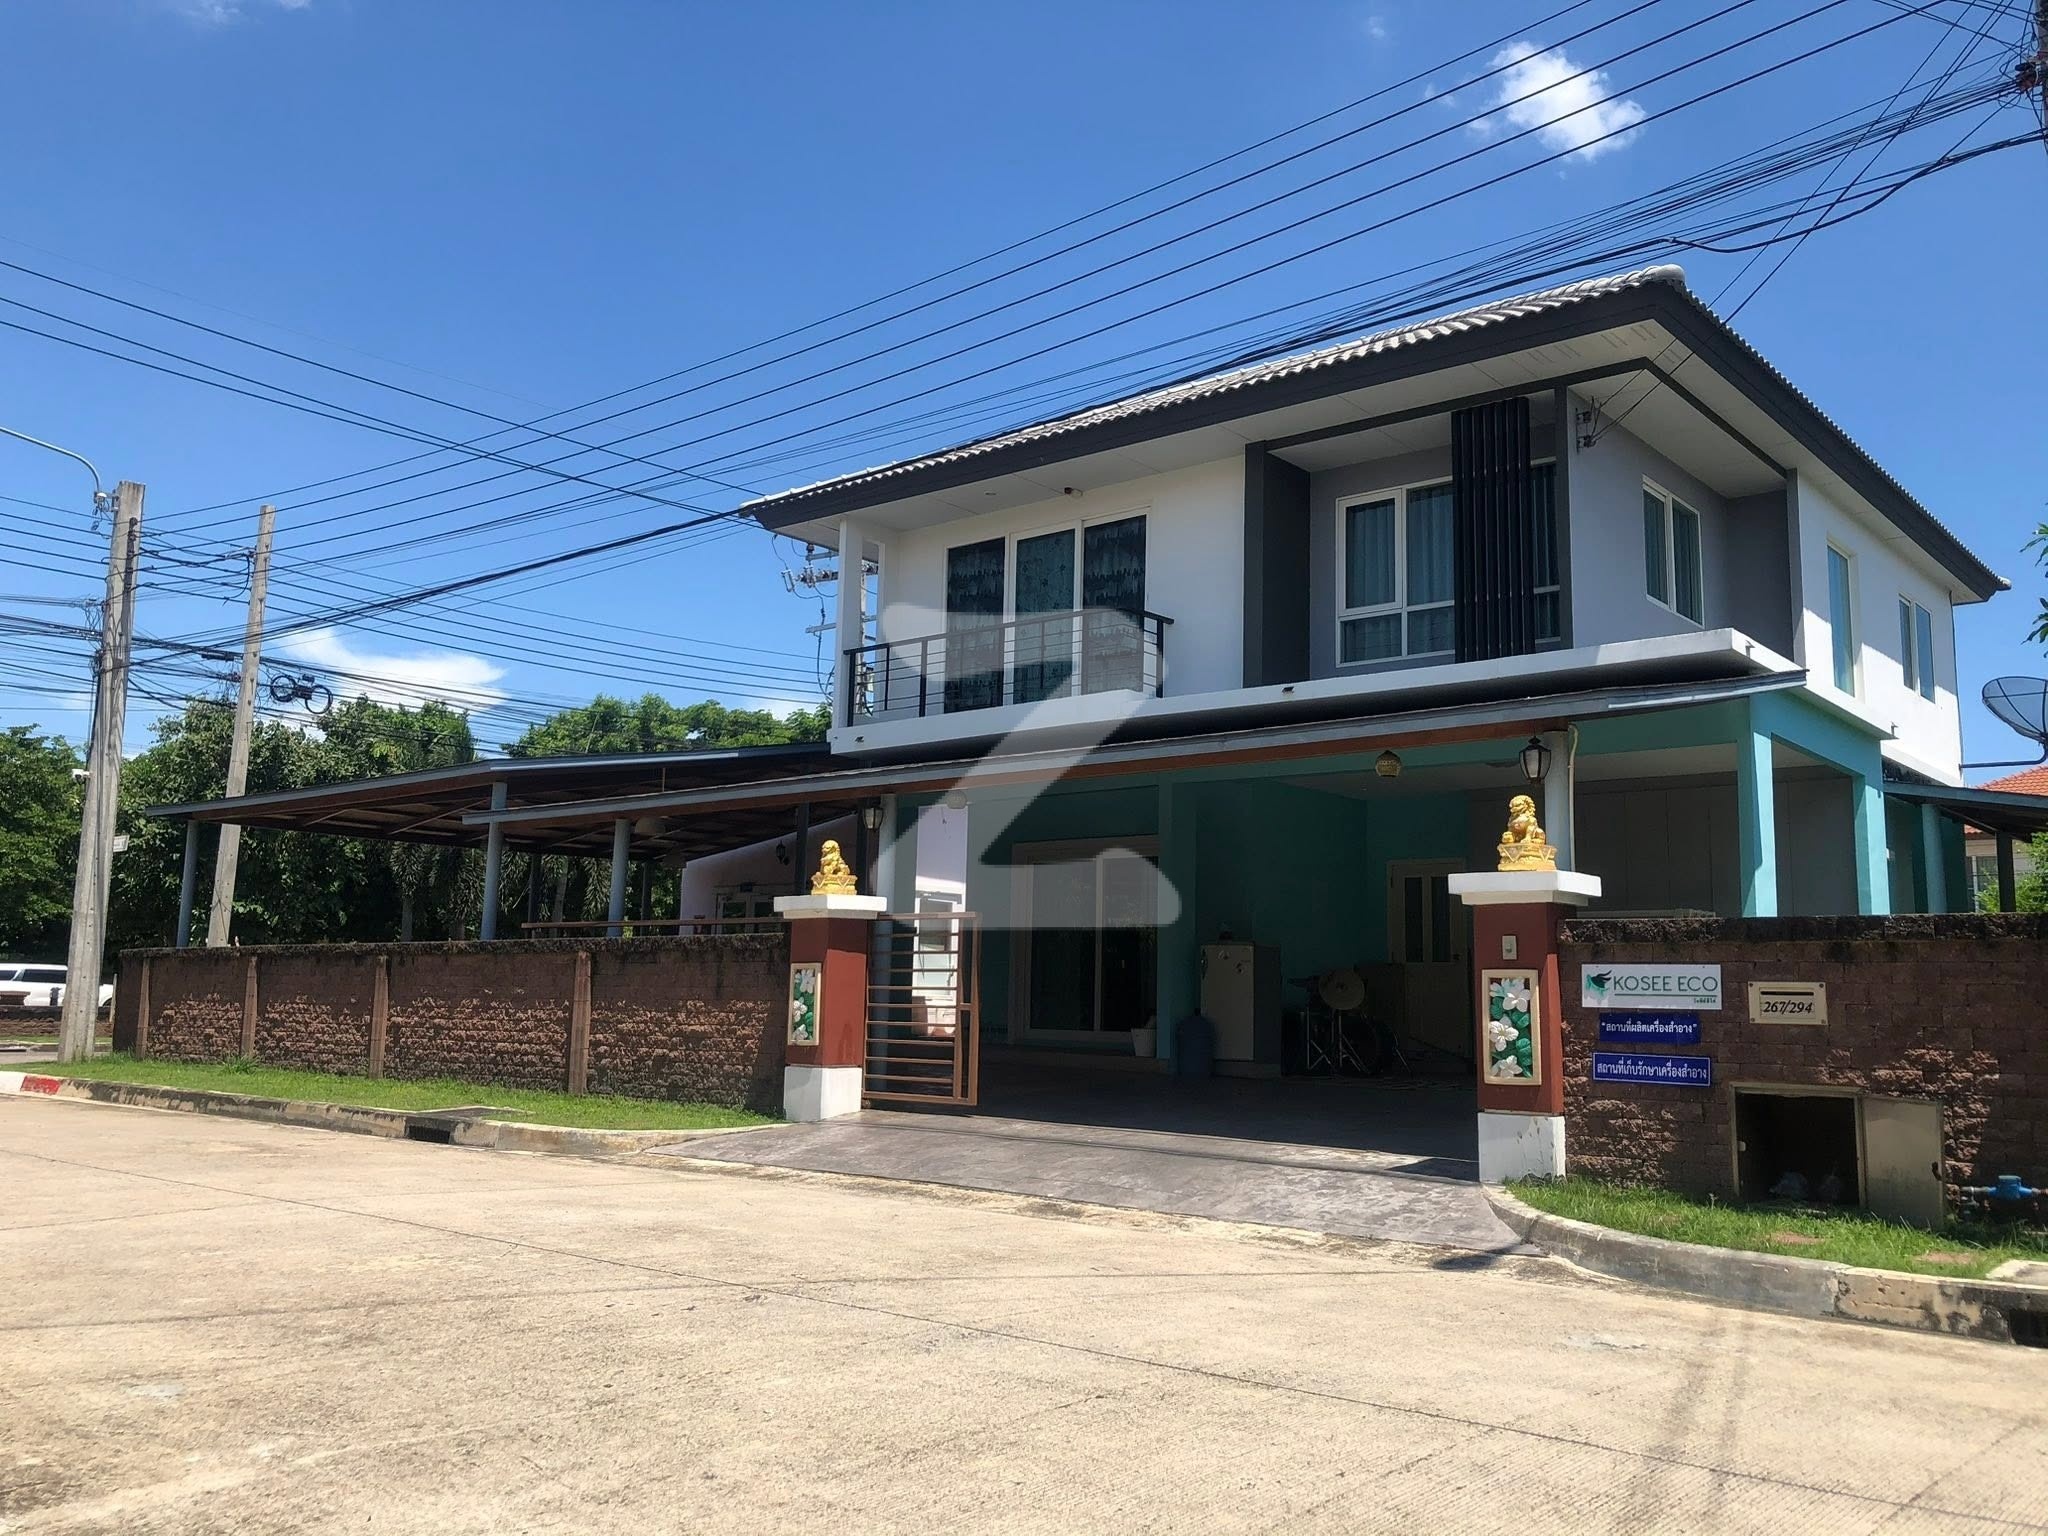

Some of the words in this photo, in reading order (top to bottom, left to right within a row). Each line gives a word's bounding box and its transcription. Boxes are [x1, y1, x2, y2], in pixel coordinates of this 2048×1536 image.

[1613, 975, 1672, 991] KOSEE
[1678, 976, 1718, 992] ECO
[1763, 1000, 1812, 1015] 267/294
[1597, 1057, 1707, 1079] สถานที่เก็บรักษาเครื่องสำอาง
